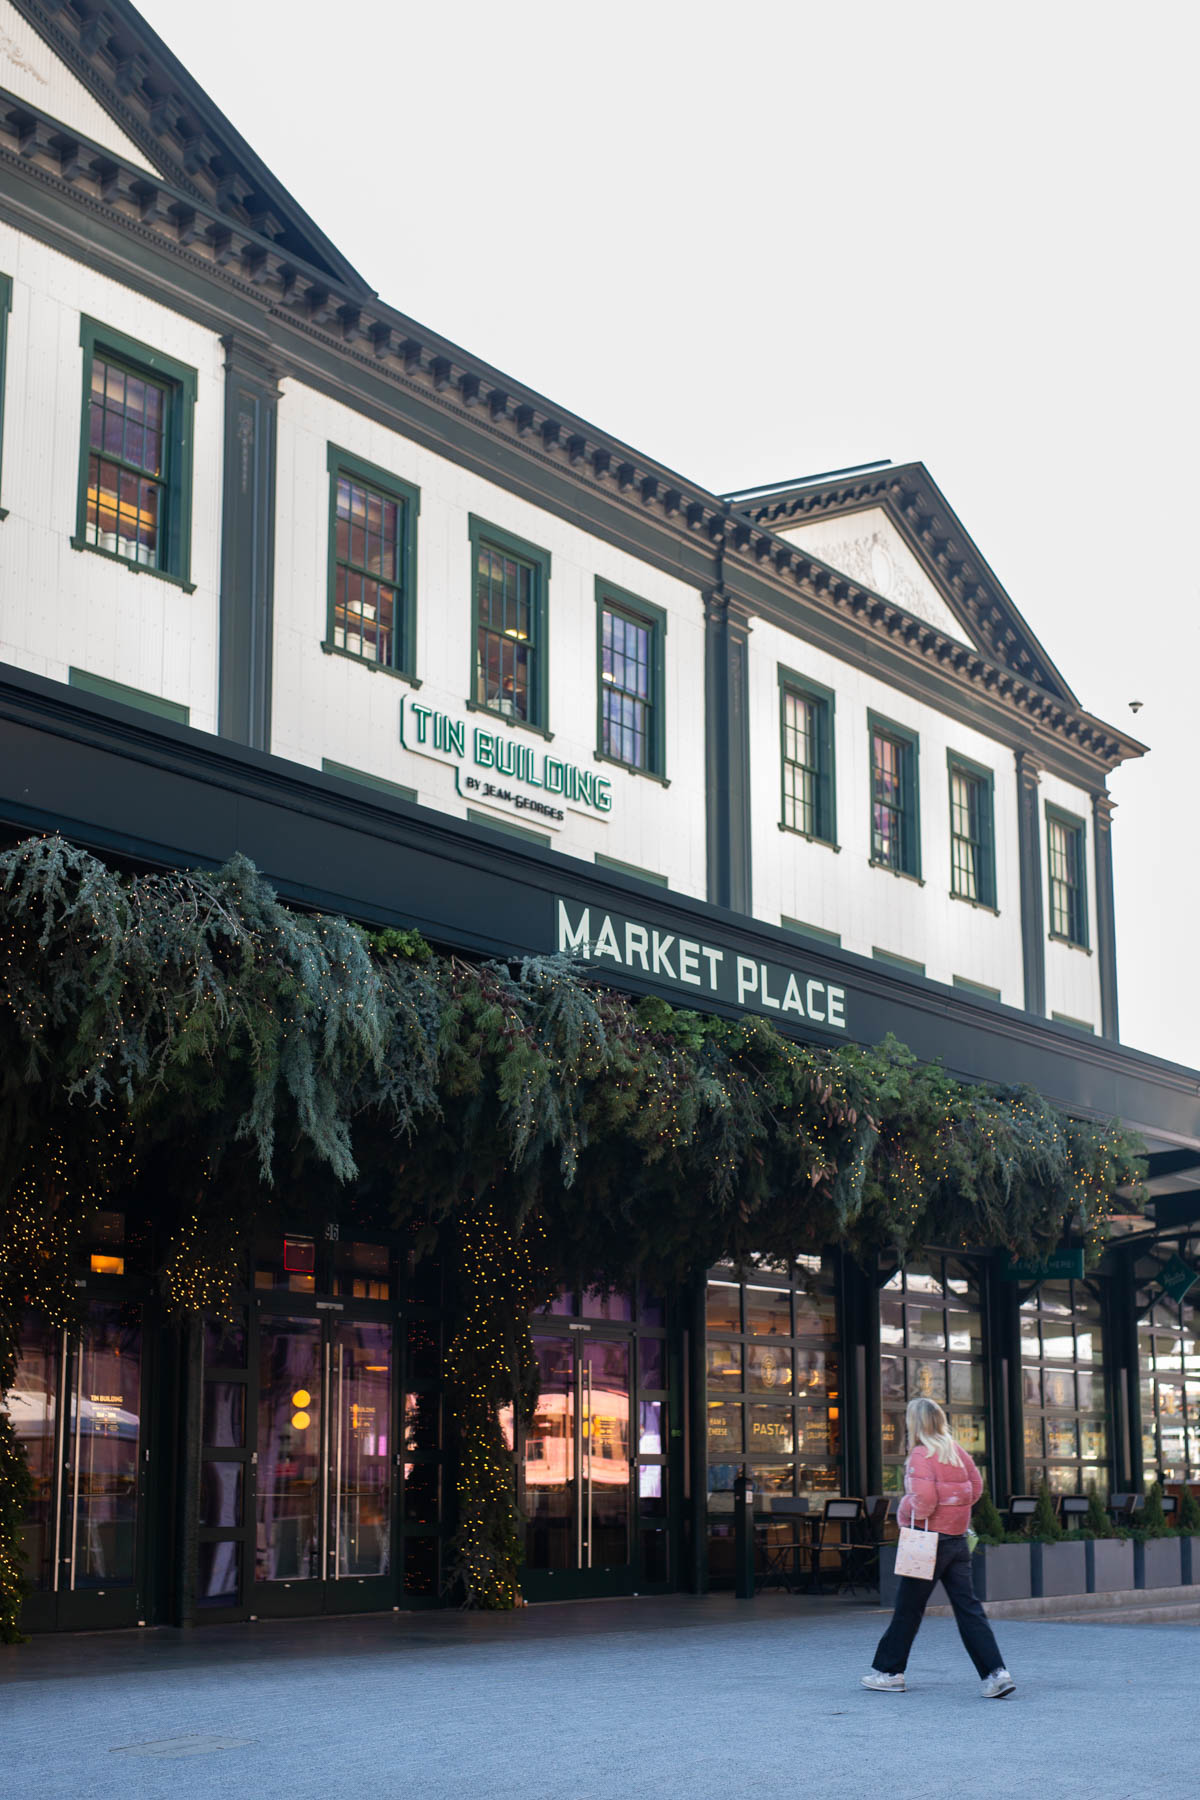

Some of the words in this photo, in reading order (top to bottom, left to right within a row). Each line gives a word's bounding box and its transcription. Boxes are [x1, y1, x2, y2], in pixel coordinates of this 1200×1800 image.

[411, 703, 465, 758] TIN
[474, 727, 612, 812] BUILDING
[465, 777, 481, 791] BY
[481, 783, 565, 821] JEAN-GEORGES
[558, 899, 724, 991] MARKET
[736, 955, 847, 1029] PLACE
[752, 1423, 787, 1436] PASTA
